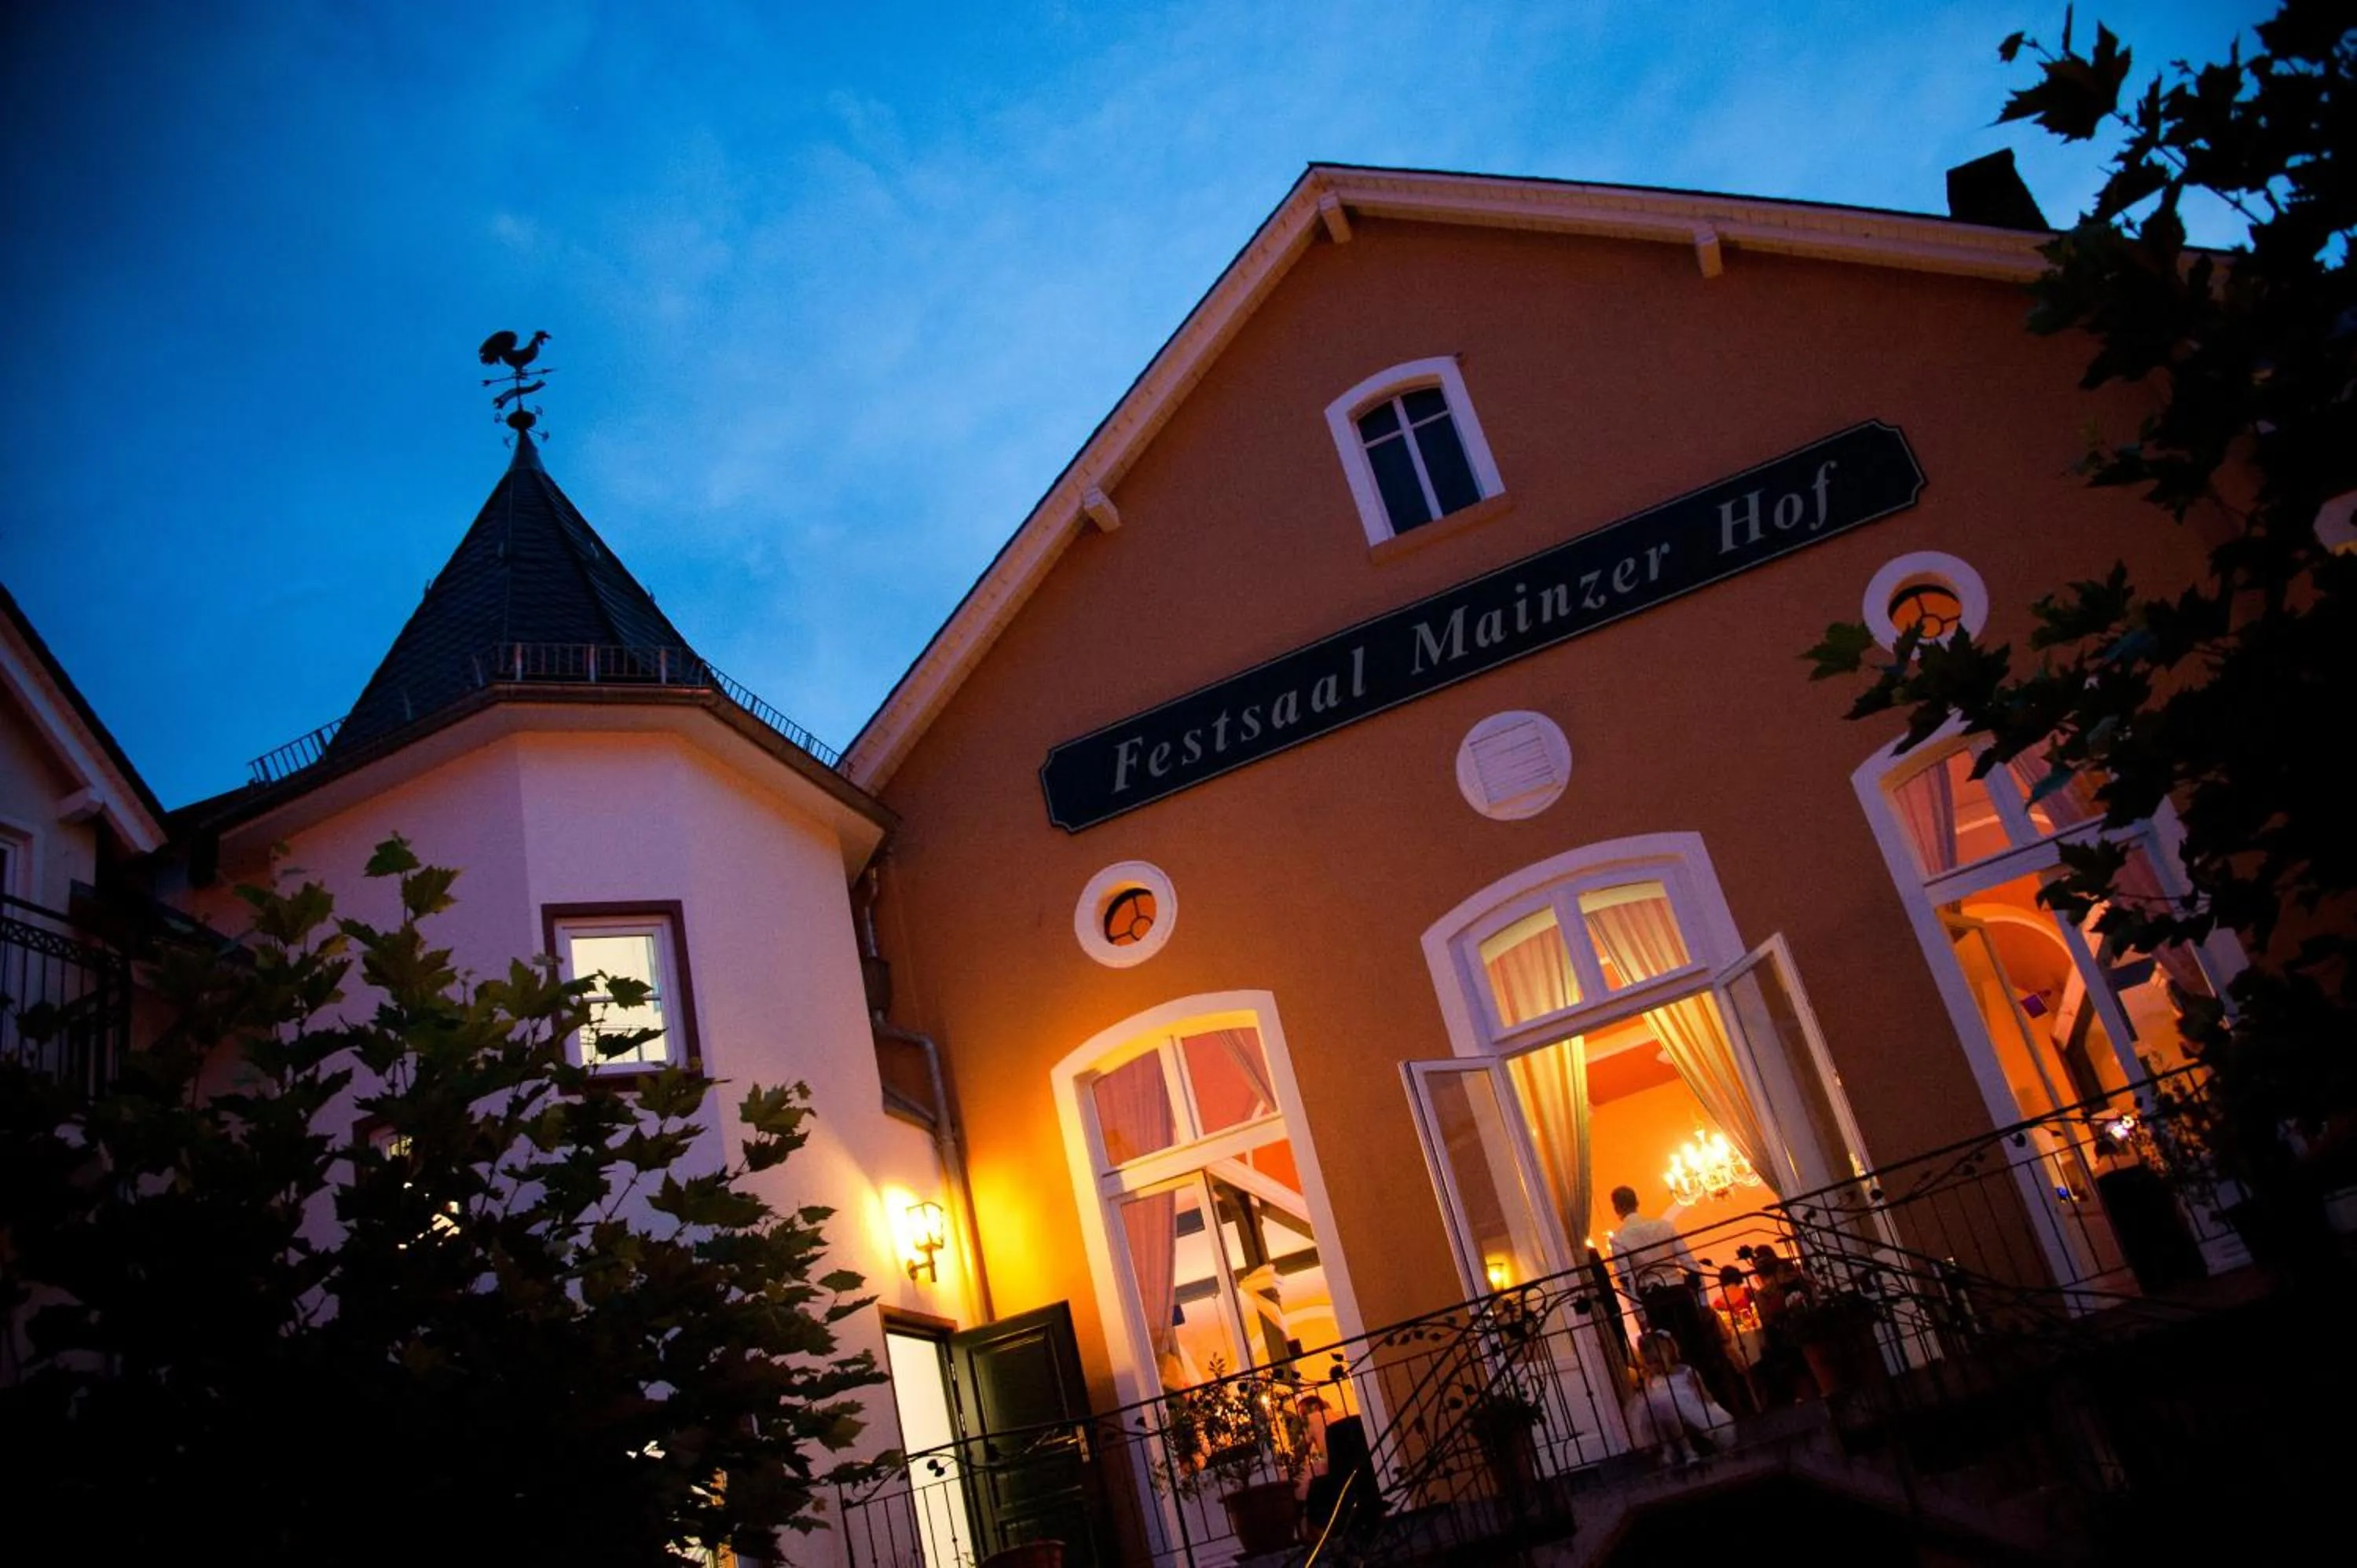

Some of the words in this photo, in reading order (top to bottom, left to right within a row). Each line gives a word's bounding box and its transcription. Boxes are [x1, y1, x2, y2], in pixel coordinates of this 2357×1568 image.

[1109, 644, 1368, 796] Festsaal
[1409, 540, 1672, 676] Mainzer
[1715, 459, 1839, 556] Hof
